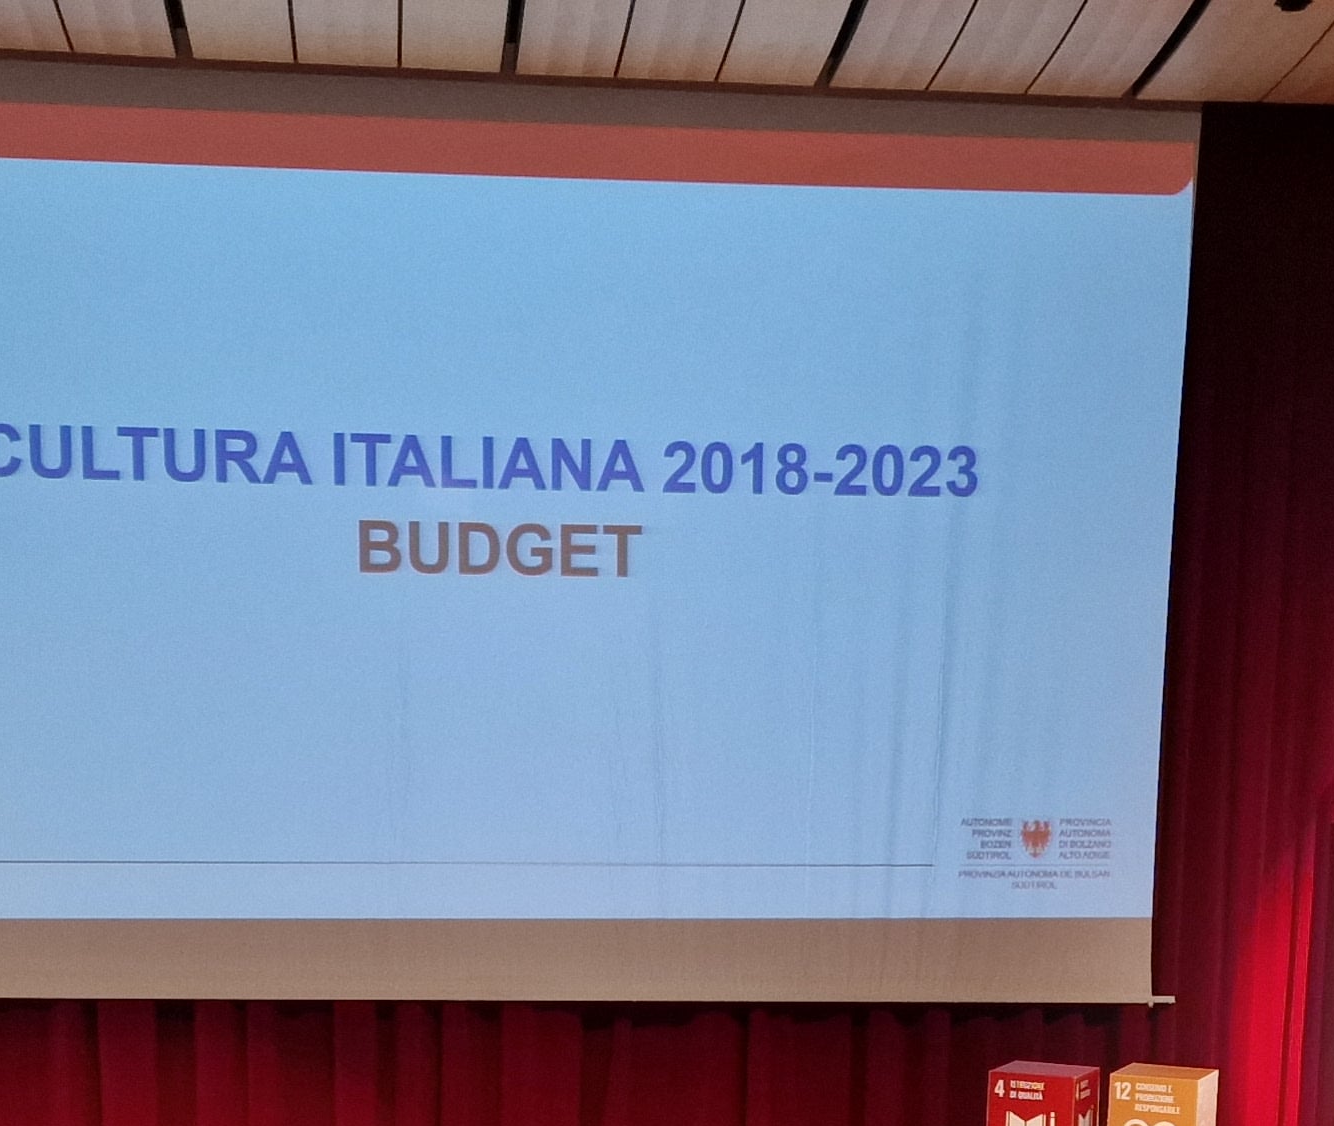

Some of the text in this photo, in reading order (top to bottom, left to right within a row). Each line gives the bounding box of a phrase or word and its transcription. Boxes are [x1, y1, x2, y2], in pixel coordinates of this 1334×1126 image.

[332, 432, 645, 493] ITALIANA
[661, 440, 980, 498] 2018-2023
[357, 519, 643, 578] BUDGET
[1059, 818, 1112, 827] PROVINCIA
[972, 829, 1012, 838] PROVINZ
[1059, 829, 1111, 838] AUTONOMA
[980, 840, 1012, 849] BOZEN
[1059, 840, 1112, 849] DI BOLZANO
[1059, 851, 1081, 860] ALTO
[994, 1079, 1005, 1098] 4
[1114, 1081, 1132, 1100] 12
